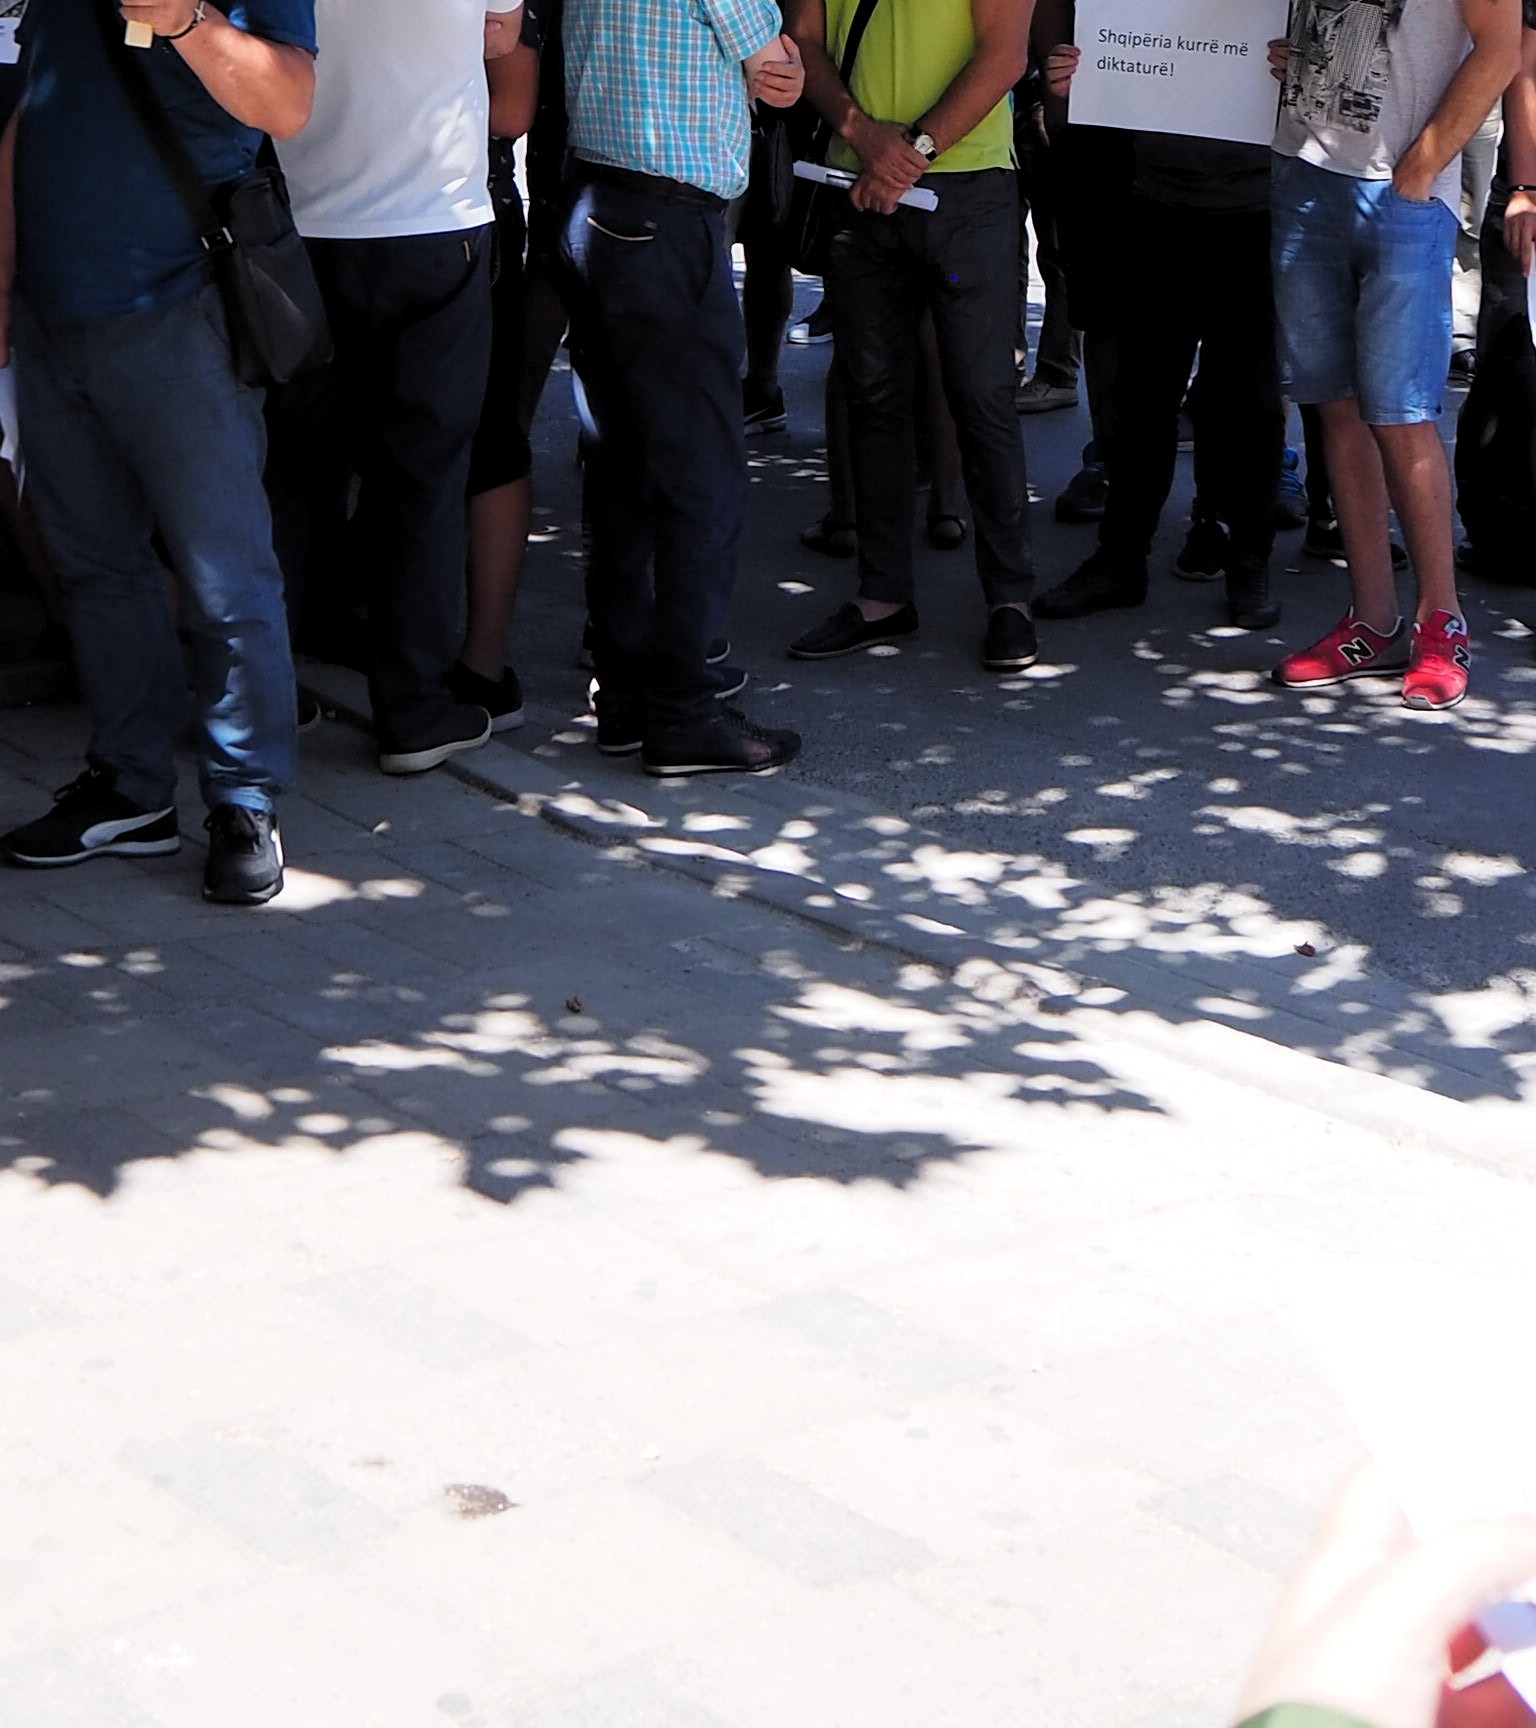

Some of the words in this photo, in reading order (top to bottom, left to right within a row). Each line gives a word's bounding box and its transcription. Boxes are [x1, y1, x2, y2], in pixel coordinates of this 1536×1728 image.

[1098, 29, 1172, 49] Shqipëria
[1177, 37, 1219, 54] kurrë
[1224, 42, 1249, 56] më
[1097, 57, 1174, 76] diktaturë!
[1338, 637, 1375, 666] N
